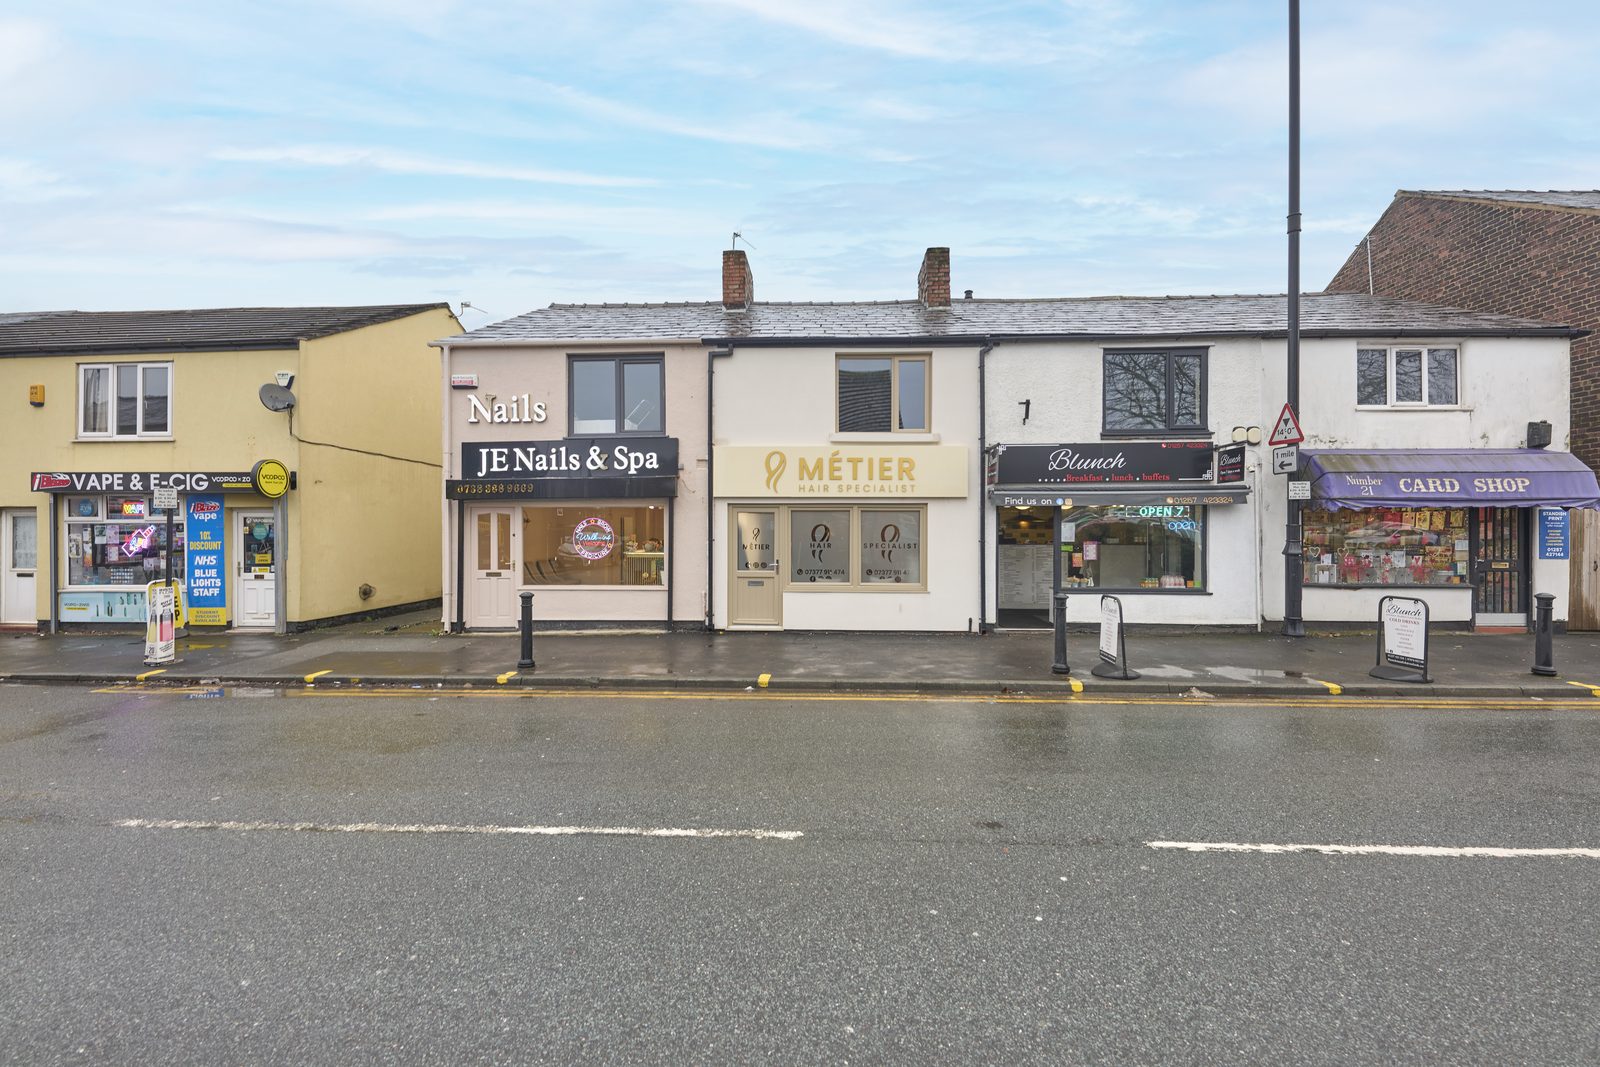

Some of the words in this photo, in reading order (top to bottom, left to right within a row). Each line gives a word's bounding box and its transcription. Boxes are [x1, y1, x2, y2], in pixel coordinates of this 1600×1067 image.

[468, 393, 547, 423] Nails
[477, 448, 509, 477] JE
[513, 446, 580, 472] Nails
[586, 445, 608, 471] &
[613, 445, 659, 474] Spa
[1048, 448, 1127, 471] Blunch
[799, 450, 916, 481] MÉTIER
[72, 473, 123, 491] VAPE
[129, 473, 143, 491] &
[150, 473, 209, 491] E-CIG
[1111, 473, 1134, 482] lunch
[1142, 472, 1170, 482] buffets
[1345, 474, 1383, 487] Number
[798, 484, 830, 493] HAIR
[837, 484, 916, 493] SPECIALIST
[1360, 485, 1374, 496] 21
[1399, 477, 1460, 493] CARD
[1474, 477, 1531, 493] SHOP
[1004, 497, 1023, 505] Find
[193, 512, 217, 522] vape
[1139, 506, 1173, 517] OPEN
[1168, 519, 1196, 532] open
[190, 541, 222, 550] DISCOUNT
[194, 556, 217, 565] NHS
[194, 569, 218, 577] BLUE
[190, 578, 222, 587] LIGHTS
[193, 588, 220, 597] STAFF
[1386, 605, 1422, 617] Blunch
